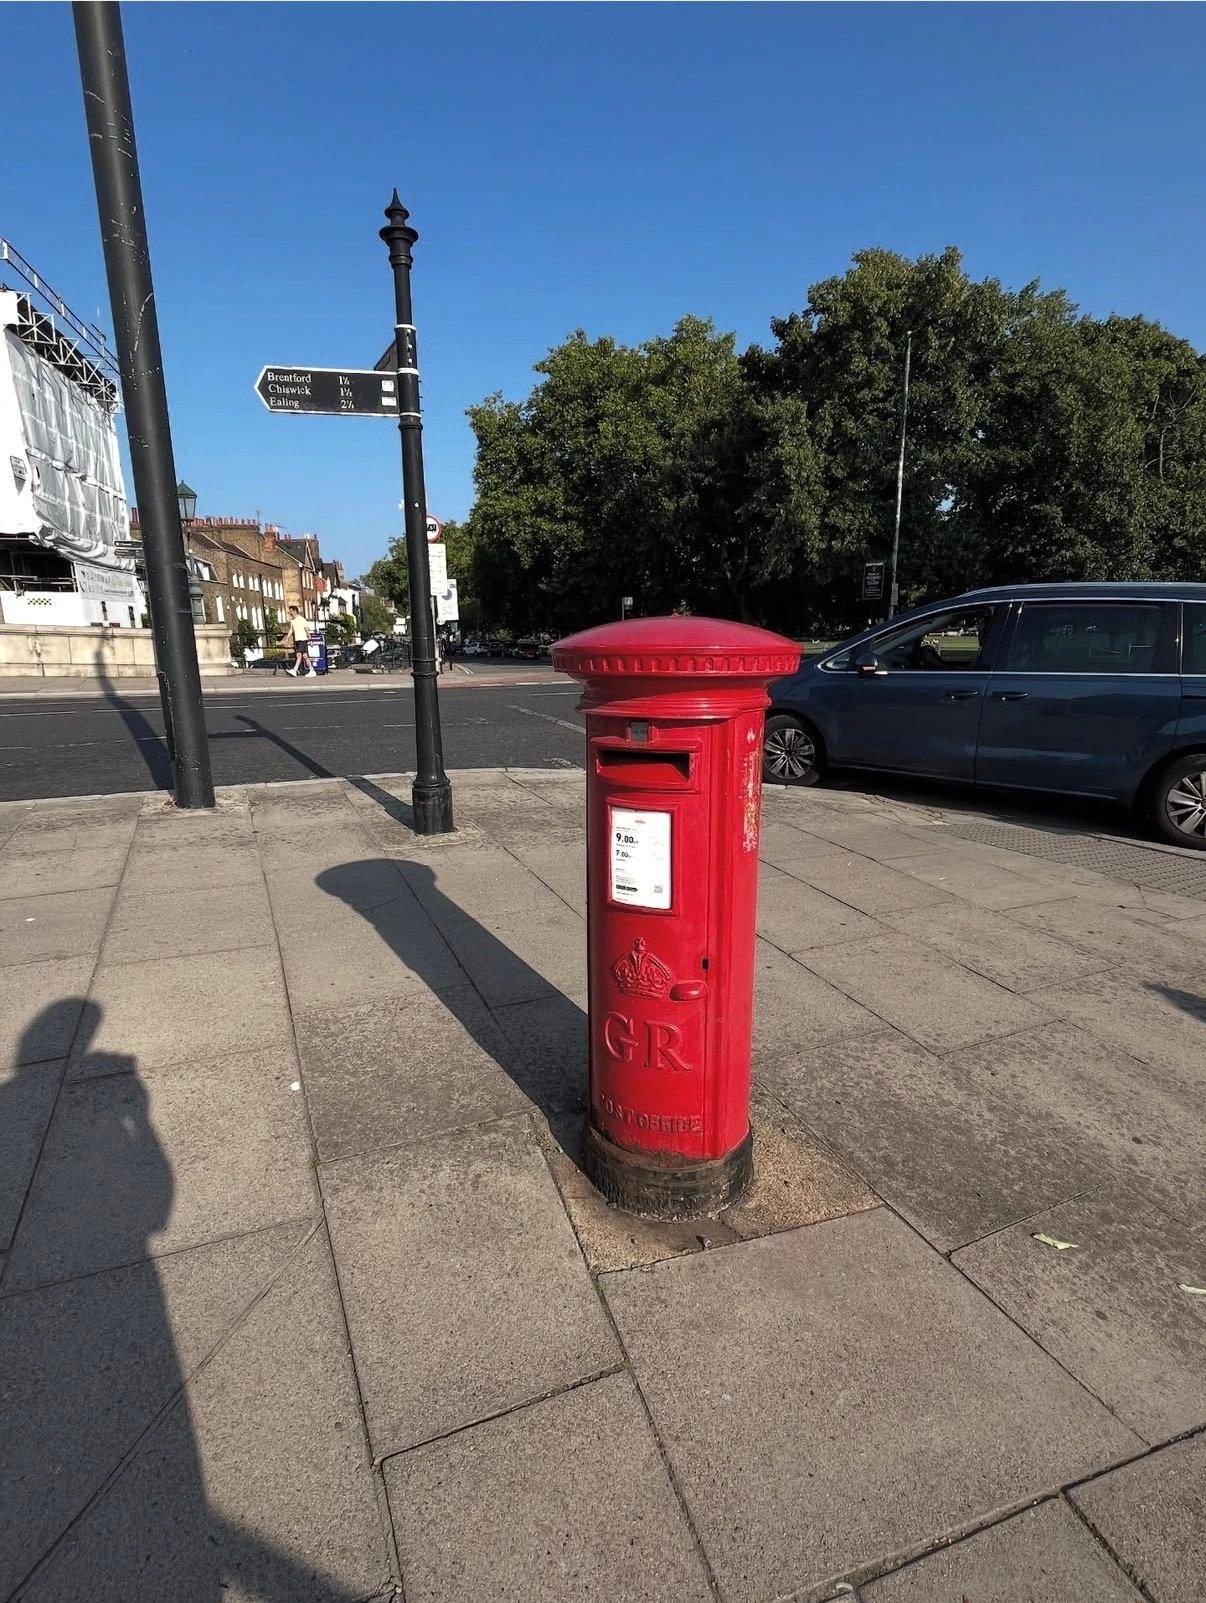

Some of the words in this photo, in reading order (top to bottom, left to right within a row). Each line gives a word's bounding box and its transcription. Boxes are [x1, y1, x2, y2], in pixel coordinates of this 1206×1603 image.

[267, 371, 312, 383] Brentford
[268, 384, 312, 396] Chiswick
[269, 397, 301, 409] Ealing
[604, 1010, 693, 1072] GR
